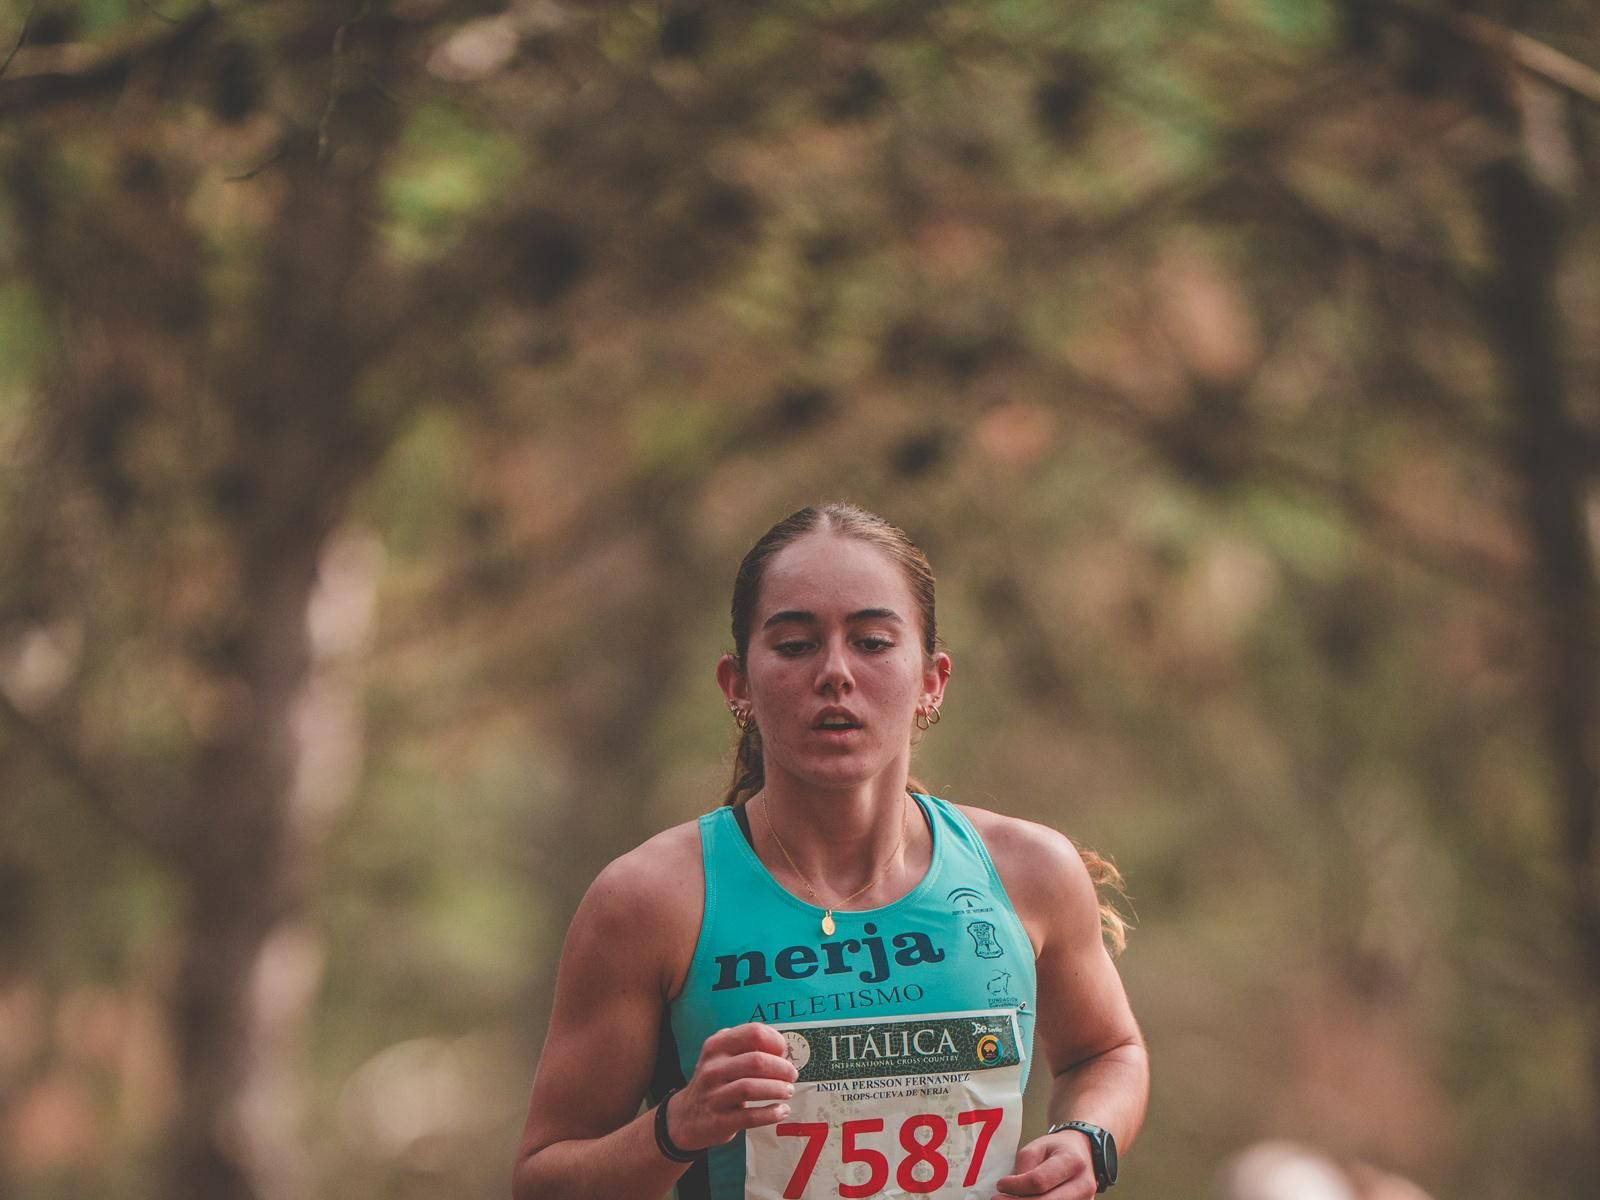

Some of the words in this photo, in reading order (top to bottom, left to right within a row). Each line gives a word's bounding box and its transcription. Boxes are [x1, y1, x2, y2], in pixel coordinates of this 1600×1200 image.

[712, 922, 946, 991] nerja
[749, 984, 924, 1022] ATLETISMO
[829, 1026, 958, 1061] ITÁLICA
[831, 1061, 895, 1069] INTERNATIONAL
[923, 1055, 959, 1063] COUNTRY
[816, 1082, 849, 1092] INDIA
[852, 1078, 902, 1090] PERSSON
[905, 1073, 970, 1086] FERNANDEZ
[841, 1090, 903, 1101] TROPS-CUEVA
[906, 1089, 918, 1097] DE
[919, 1087, 949, 1096] NERJA
[776, 1107, 1004, 1200] 7587
